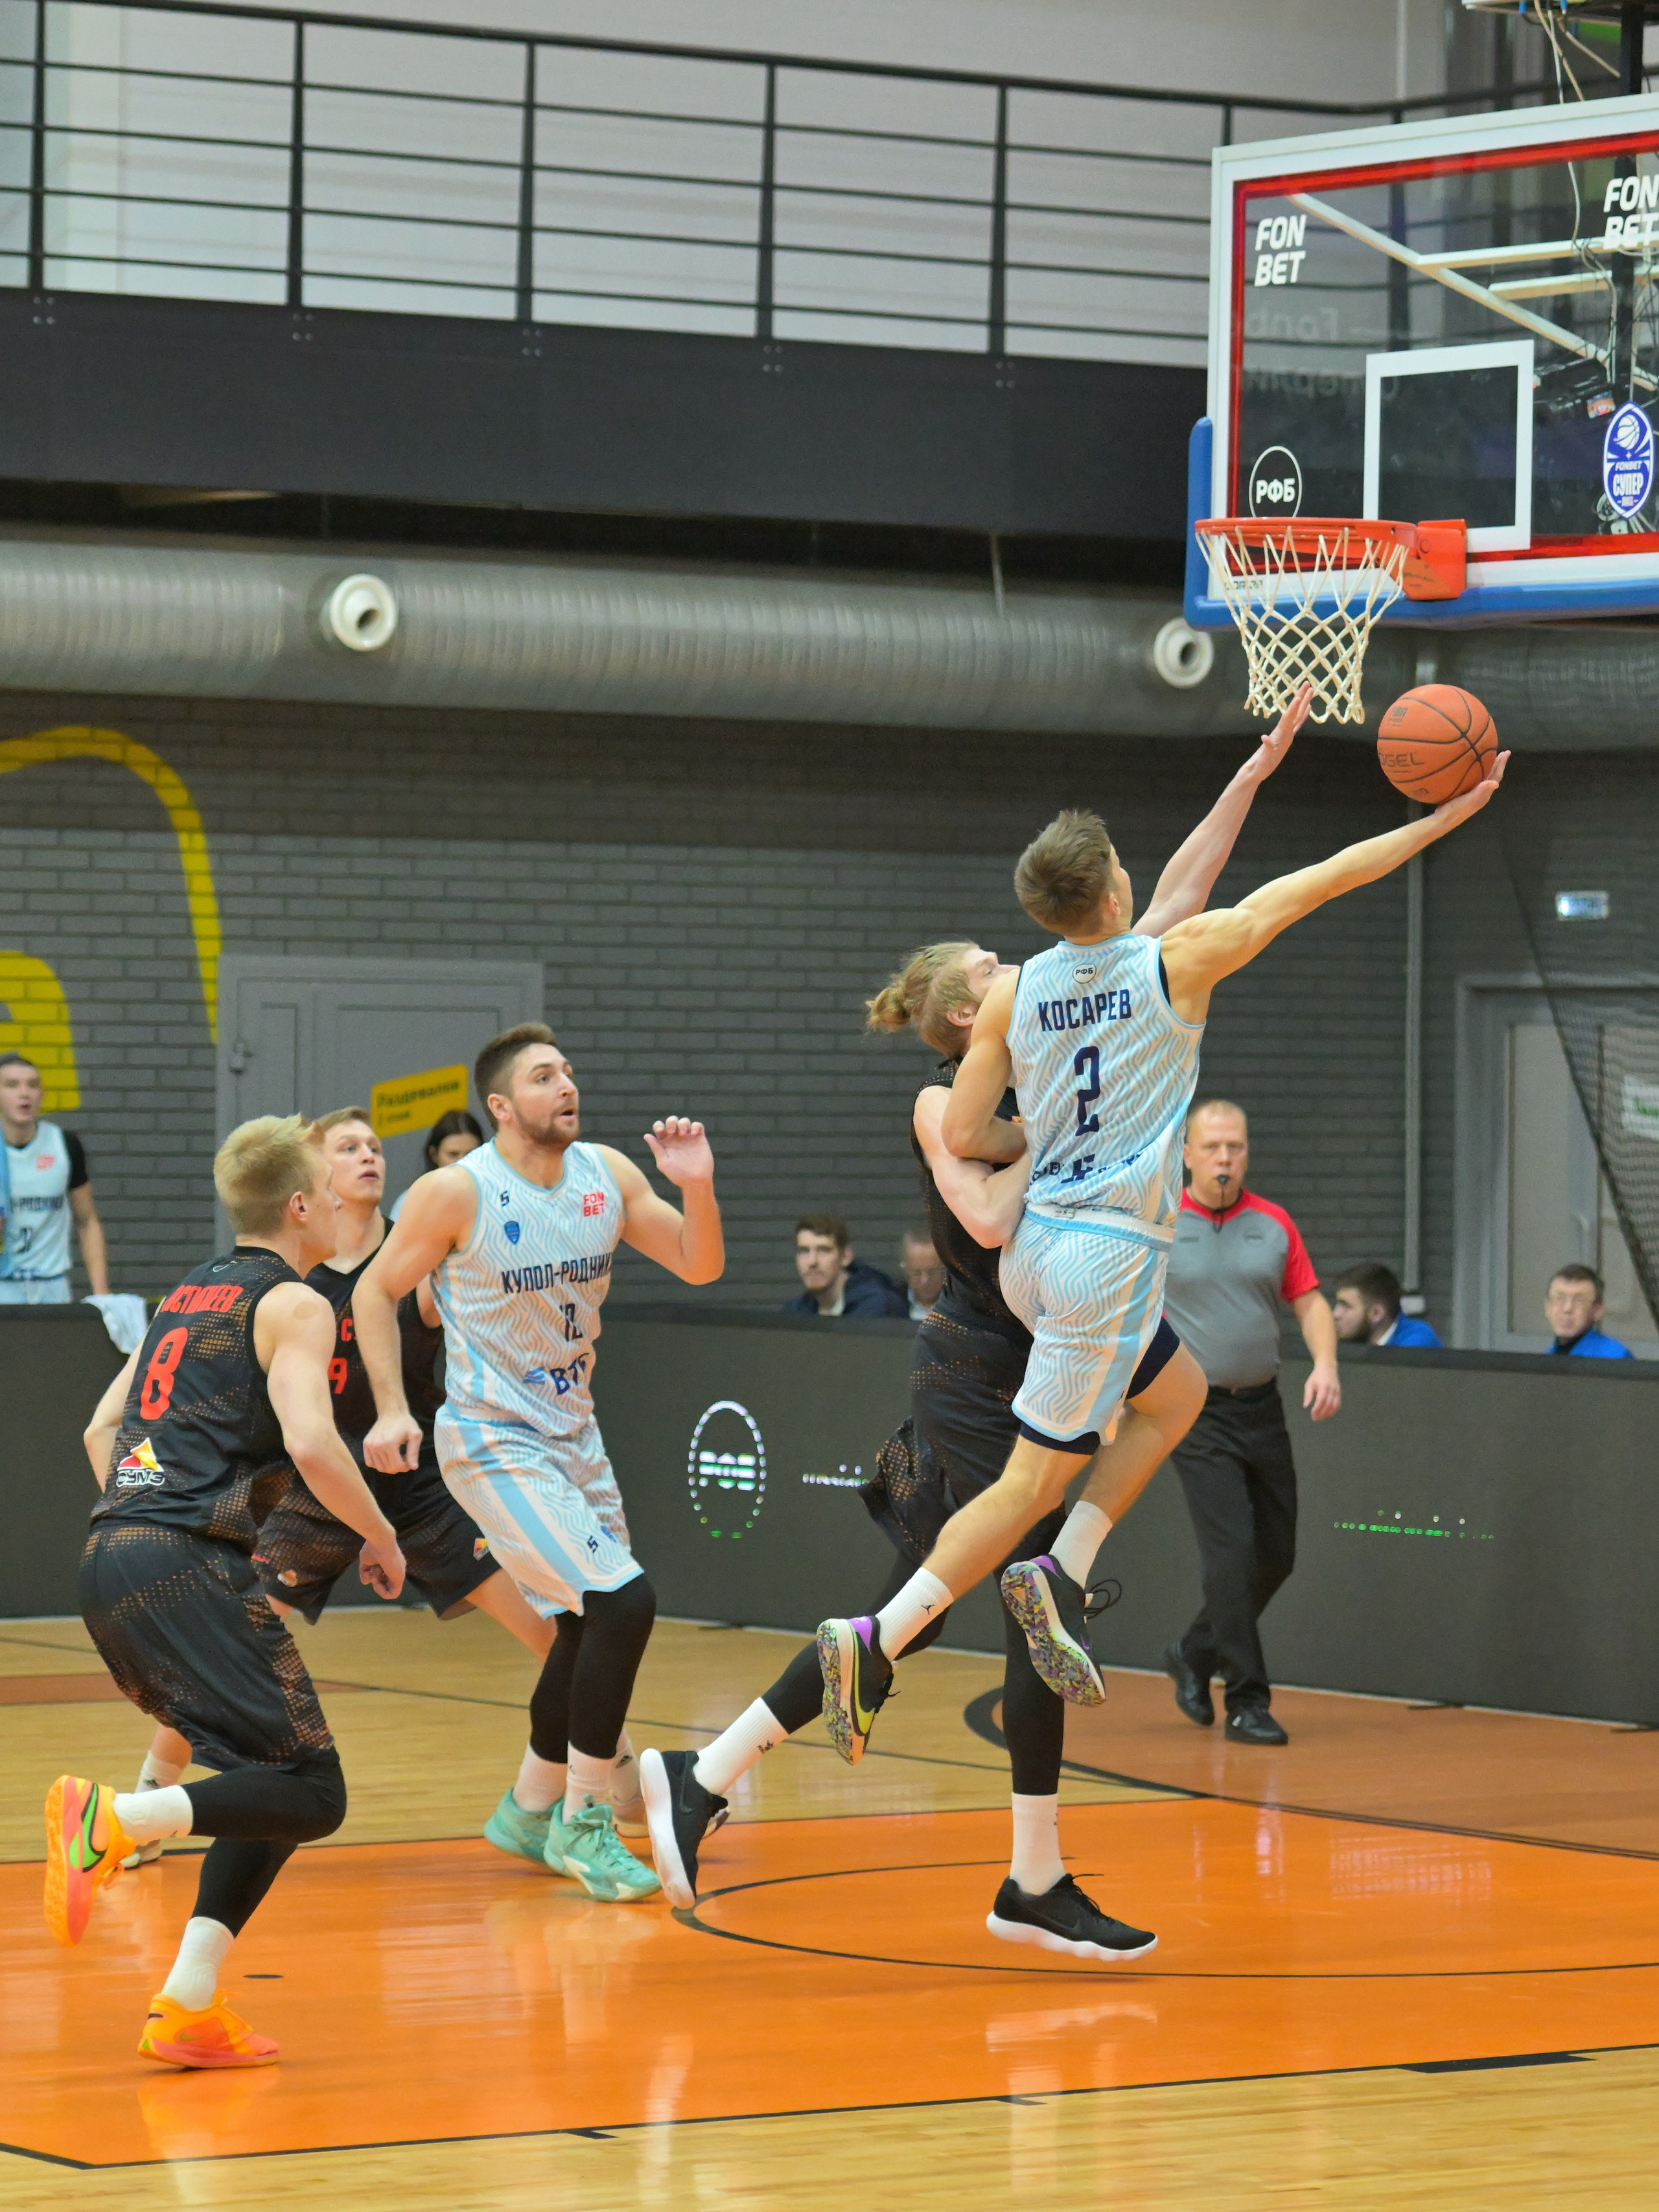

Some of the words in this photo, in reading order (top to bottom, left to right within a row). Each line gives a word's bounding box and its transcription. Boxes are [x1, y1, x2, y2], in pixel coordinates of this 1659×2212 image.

[1603, 174, 1659, 213] FON
[1255, 214, 1306, 251] FON
[1603, 212, 1659, 250] BET
[1254, 250, 1306, 286] BET
[1256, 478, 1295, 504] РФБ
[1075, 967, 1094, 976] РФБ
[1038, 989, 1131, 1031] КОСАРЕВ
[1074, 1046, 1101, 1136] 2
[583, 1191, 604, 1205] FON
[583, 1203, 604, 1217] BET
[140, 1327, 189, 1420] 8
[327, 1357, 347, 1394] 9
